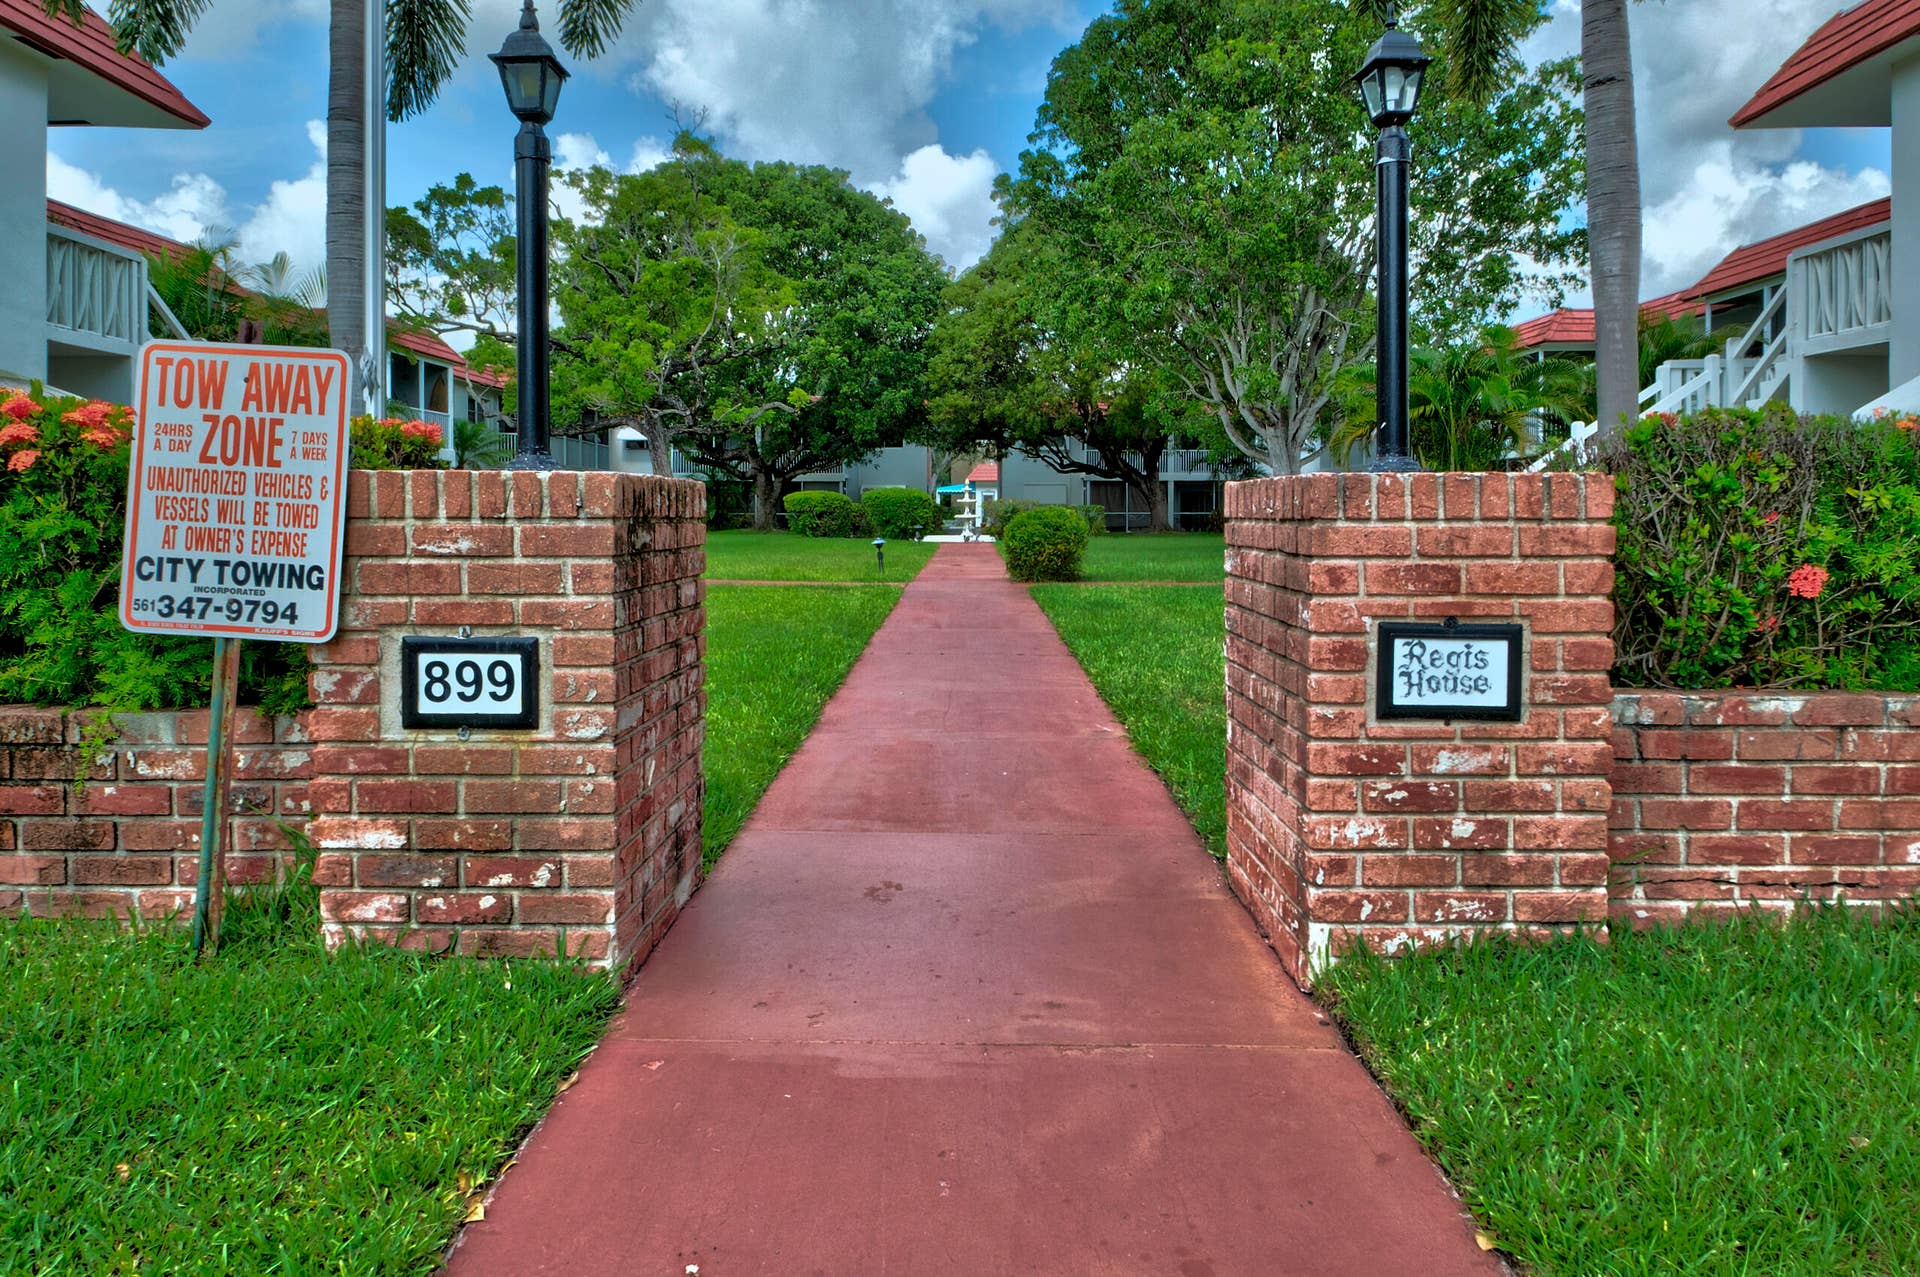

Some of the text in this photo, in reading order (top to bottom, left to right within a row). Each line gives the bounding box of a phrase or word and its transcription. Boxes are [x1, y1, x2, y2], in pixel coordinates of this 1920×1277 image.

[155, 357, 335, 416] TOW AWAY
[154, 422, 193, 438] 24HRS
[154, 439, 192, 453] A DAY
[199, 414, 285, 468] ZONE
[291, 431, 328, 446] 7 DAYS
[290, 447, 328, 461] A WEEK
[147, 465, 247, 496] UNAUTHORIZED
[255, 471, 313, 500] VEHICLES
[154, 495, 319, 530] VESSELS WILL BE TOWED
[161, 524, 308, 558] AT OWNER'S EXPENSE
[135, 555, 325, 591] CITY TOWING
[193, 585, 266, 598] INCORPORATED
[132, 598, 156, 613] 561
[157, 594, 299, 625] 347-9794
[1398, 639, 1489, 675] Regis
[424, 660, 515, 703] 899
